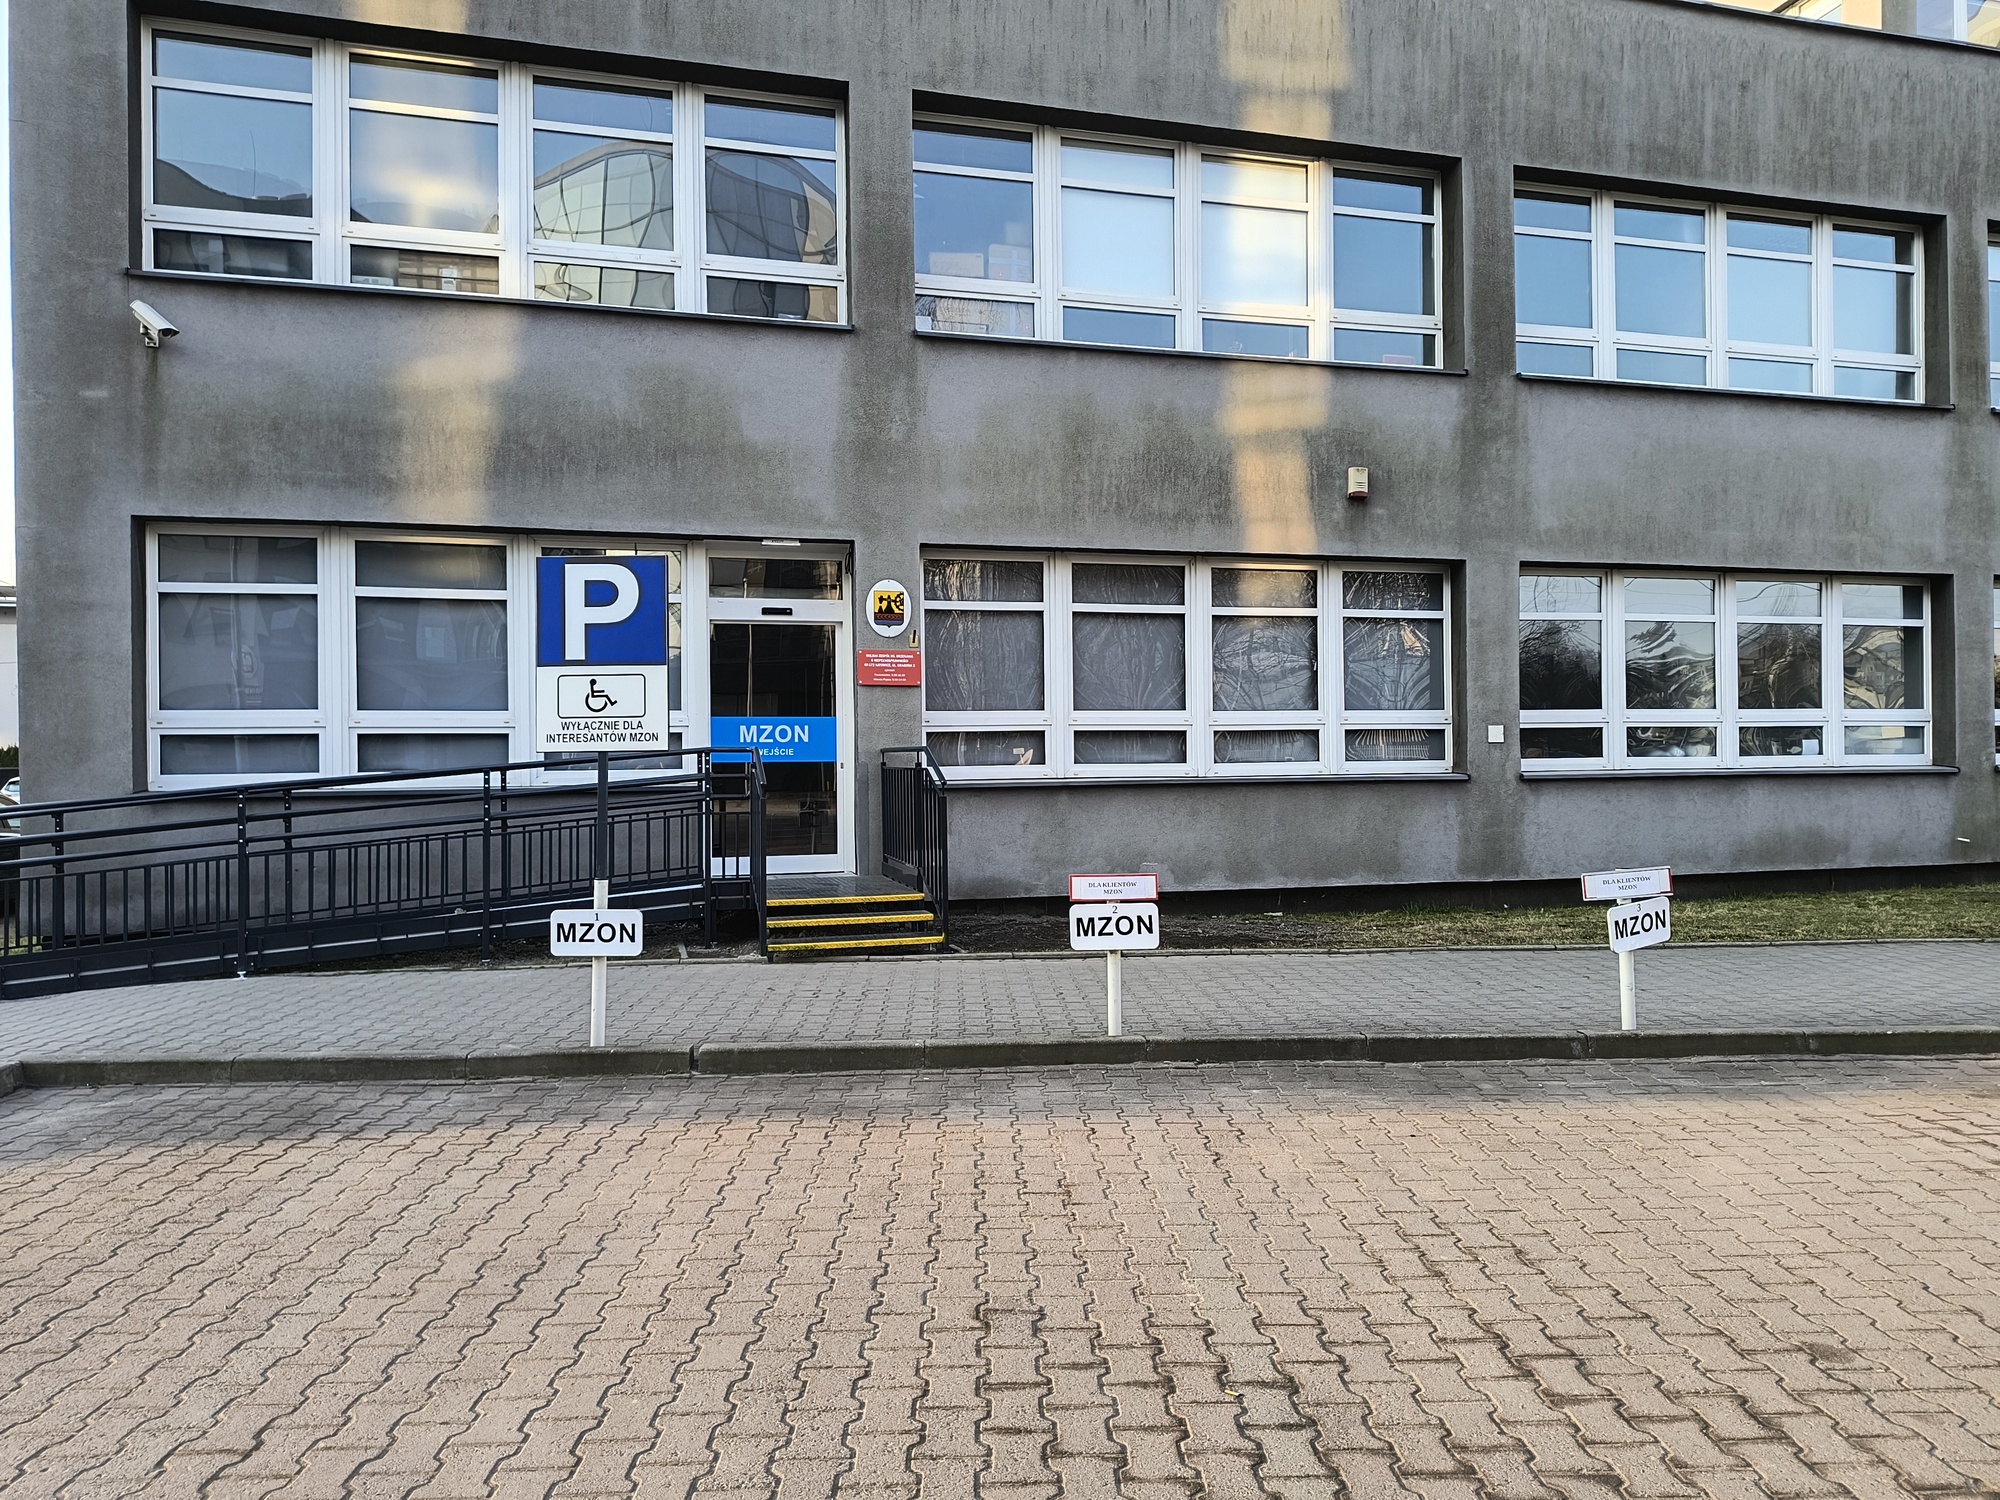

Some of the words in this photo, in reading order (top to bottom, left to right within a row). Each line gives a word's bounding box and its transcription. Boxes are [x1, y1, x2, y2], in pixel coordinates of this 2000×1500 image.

[564, 563, 639, 660] P
[560, 720, 620, 732] WYŁĄCZNIE
[623, 720, 644, 730] DLA
[546, 731, 627, 743] INTERESANTÓW
[629, 732, 659, 742] MZON
[739, 725, 809, 743] MZON
[1616, 876, 1651, 884] KLIENTÓW
[1112, 905, 1118, 914] 2
[1636, 903, 1641, 912] 3
[594, 913, 600, 921] 1
[1076, 914, 1154, 938] MZON
[1614, 909, 1666, 940] MZON
[556, 923, 636, 943] MZON
